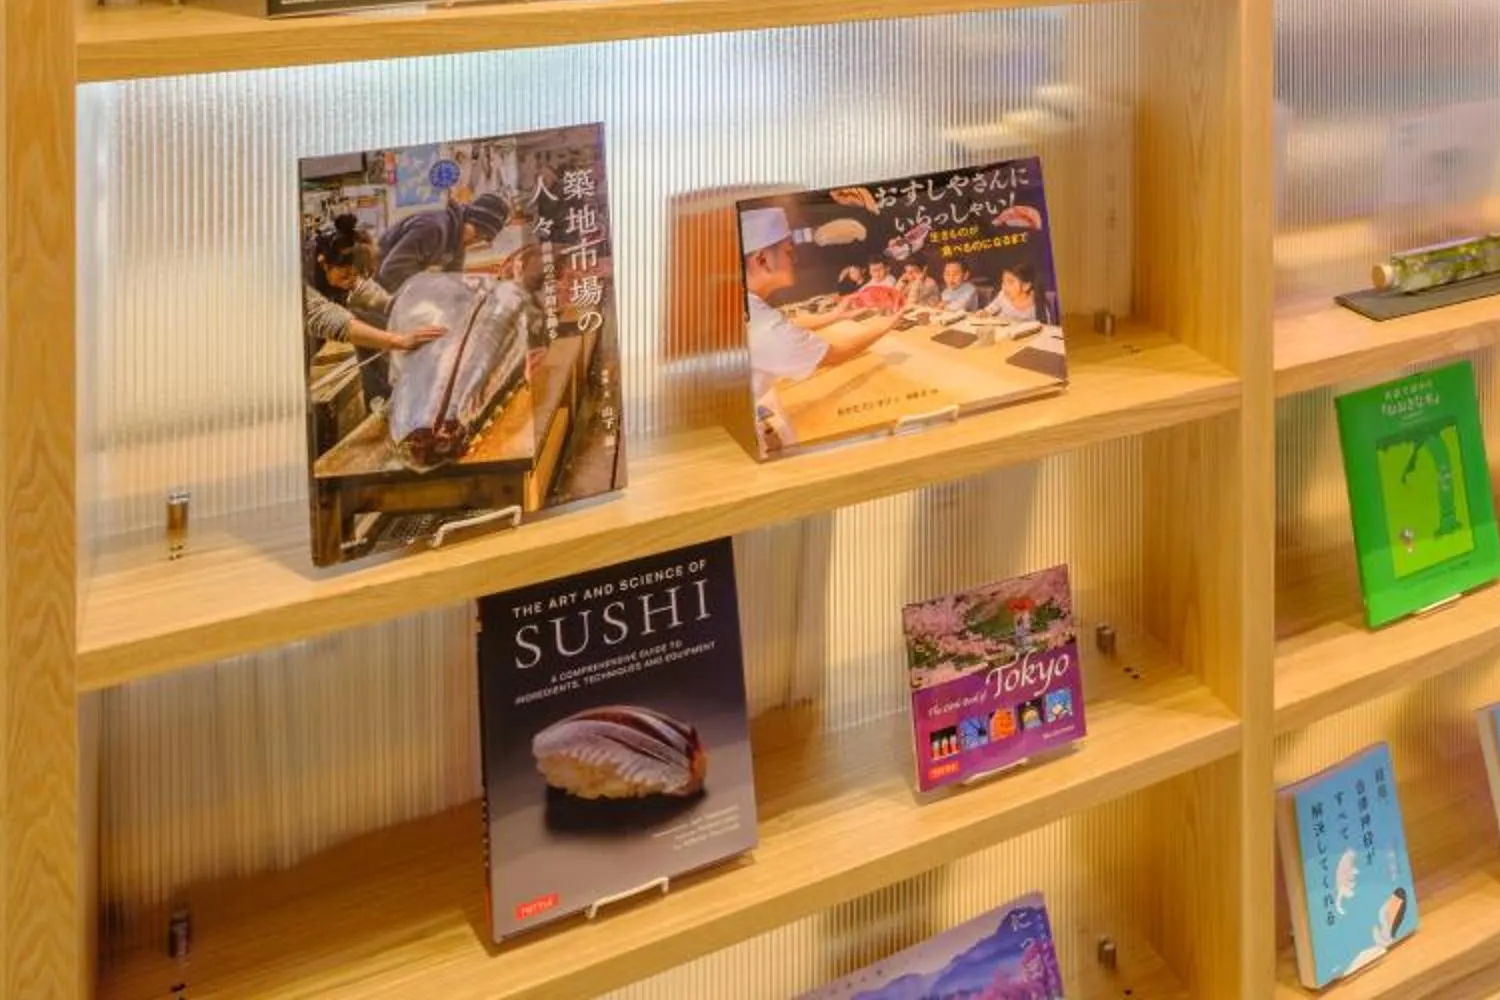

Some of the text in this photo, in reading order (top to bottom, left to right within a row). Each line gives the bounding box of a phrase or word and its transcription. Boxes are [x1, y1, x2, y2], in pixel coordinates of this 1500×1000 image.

[529, 175, 559, 234] 人々
[876, 167, 1029, 209] おすしやさんに
[560, 169, 607, 332] 築地市場の
[513, 559, 707, 618] THE ART AND SCIENCE OF
[514, 579, 712, 669] SUSHI
[559, 653, 636, 681] COMPREHENSIVE
[639, 644, 666, 657] GUIDE
[670, 640, 683, 650] TO
[644, 656, 663, 668] AND
[665, 641, 716, 663] EQUIPMENT
[985, 646, 1071, 697] Tokyo
